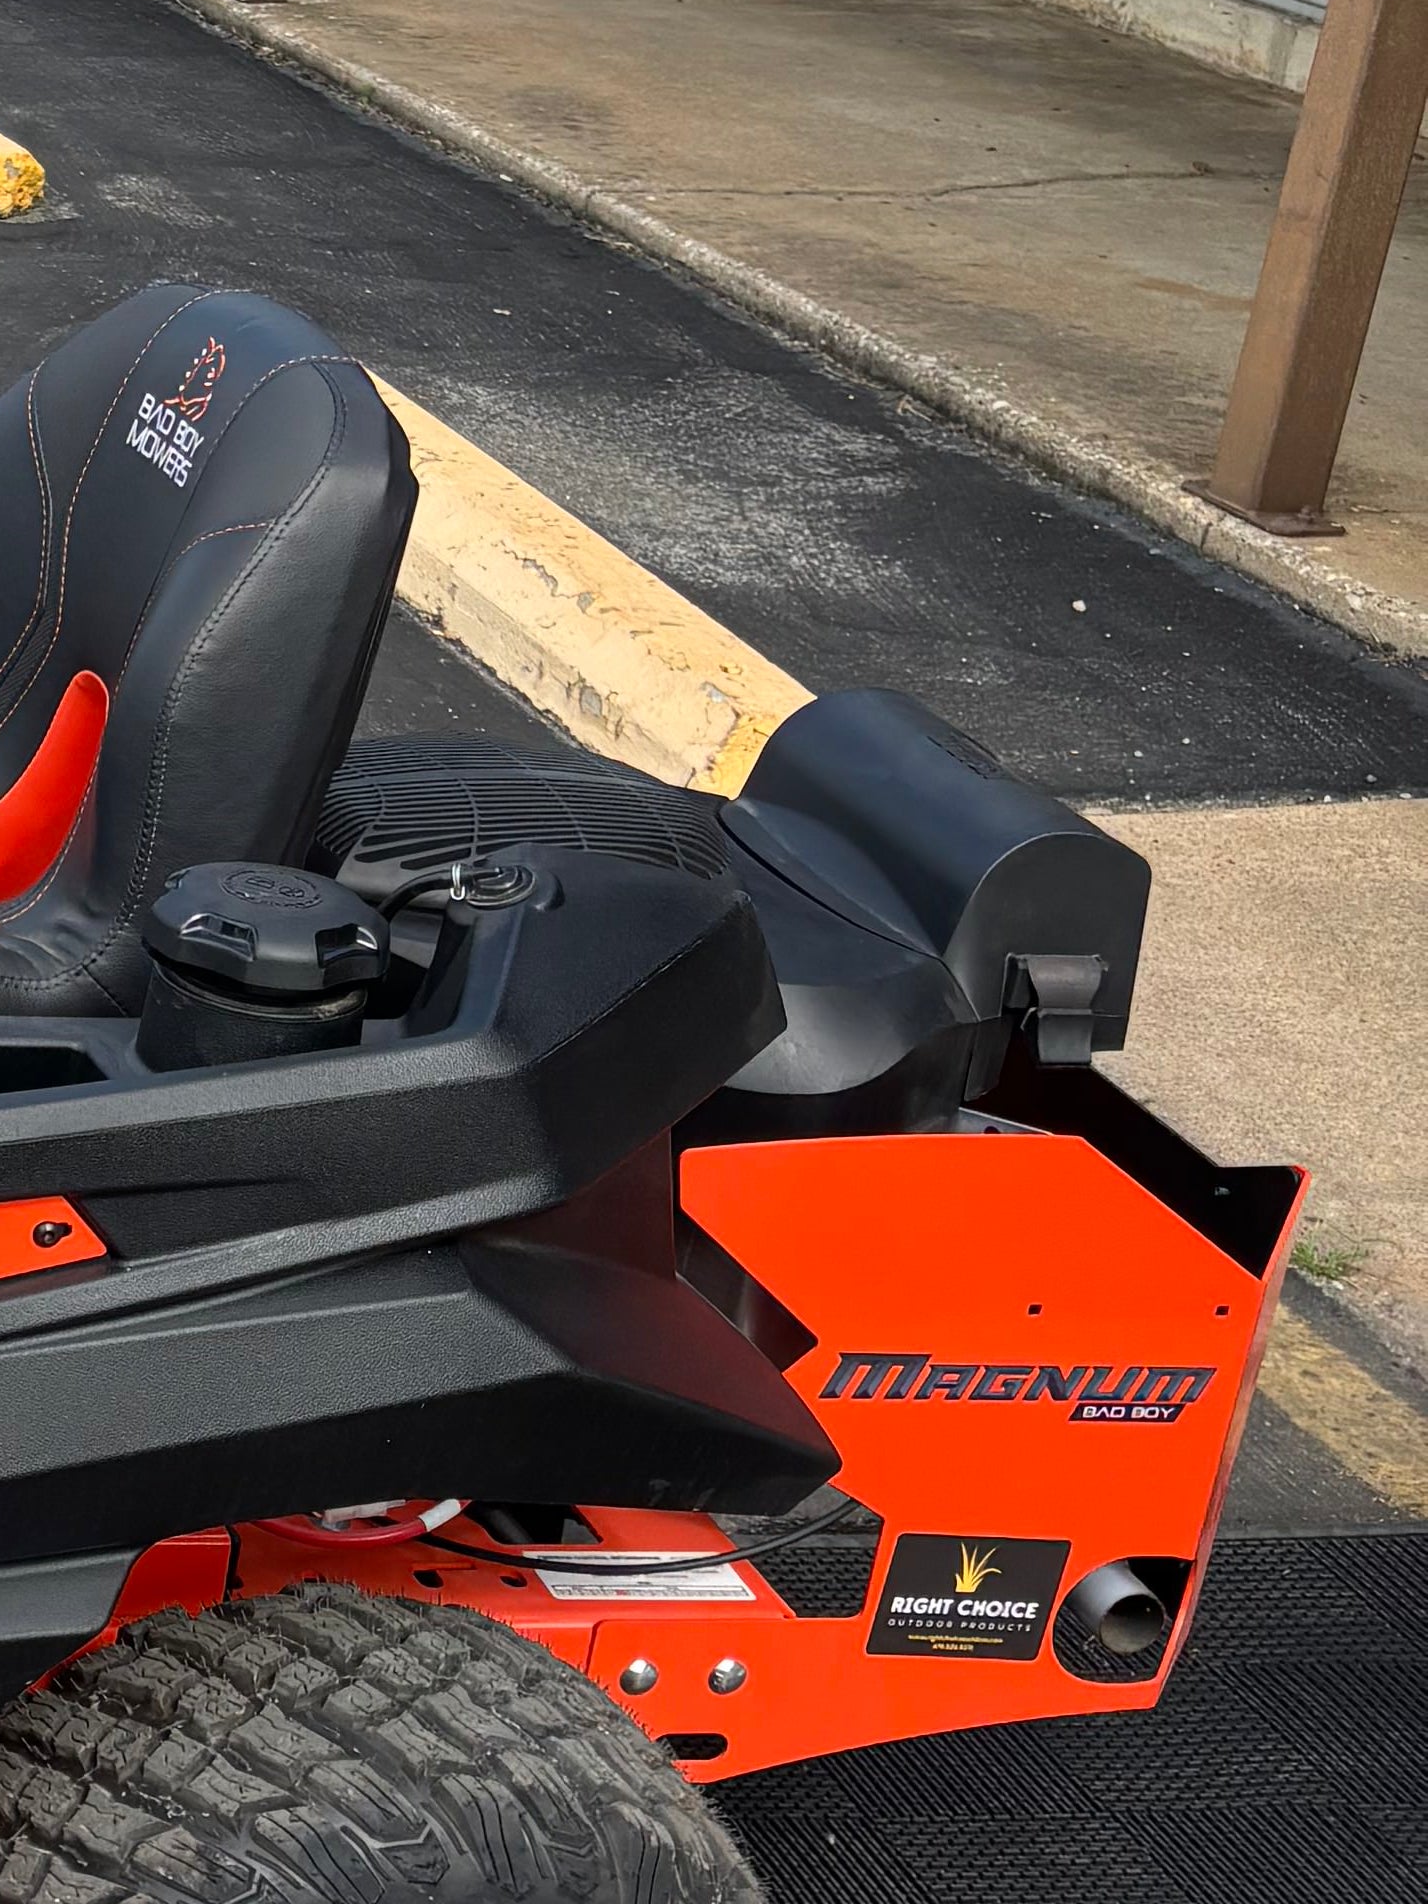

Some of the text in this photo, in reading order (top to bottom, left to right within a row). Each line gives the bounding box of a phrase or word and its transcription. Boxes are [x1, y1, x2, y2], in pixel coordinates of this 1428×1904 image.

[138, 392, 205, 459] BAD BOY
[125, 418, 194, 488] MOWERS
[818, 1352, 1218, 1405] MAGNUM
[1082, 1404, 1178, 1421] BAD BOY
[887, 1619, 1032, 1633] OUTDOOR PRODUCTS
[891, 1596, 1040, 1619] RIGHT CHOICE
